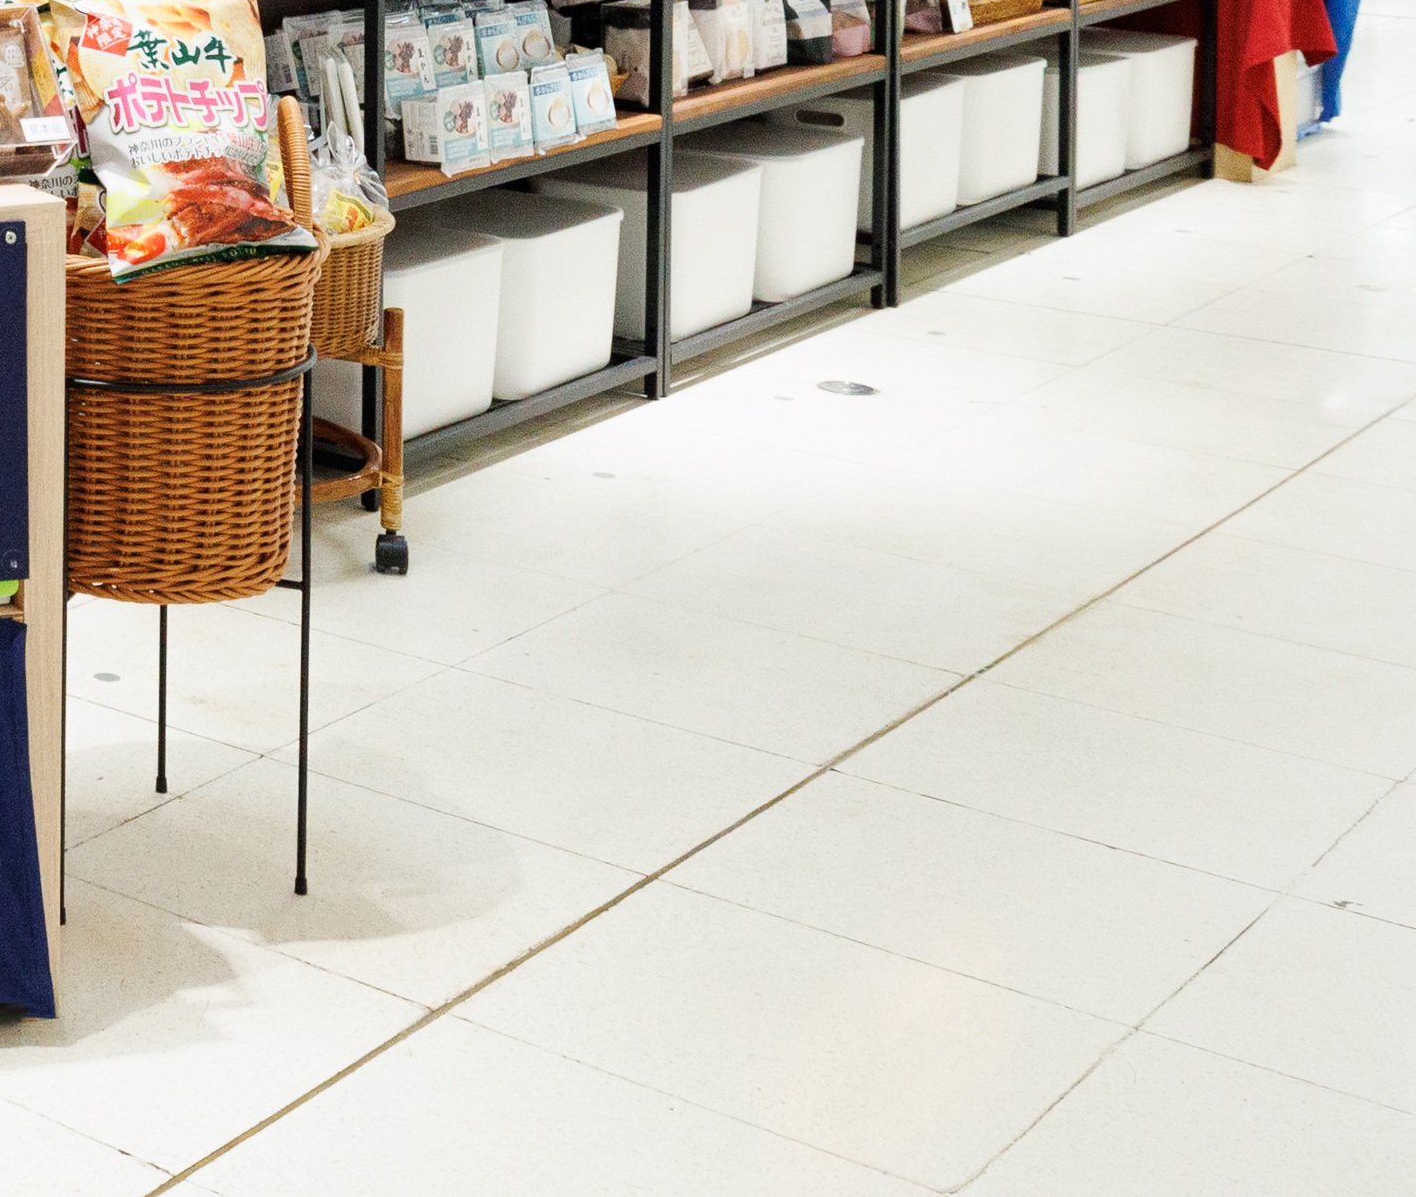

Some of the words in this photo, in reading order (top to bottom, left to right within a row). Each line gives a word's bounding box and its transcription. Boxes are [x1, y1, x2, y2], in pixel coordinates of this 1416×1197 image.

[127, 29, 233, 74] 葉山牛
[108, 74, 267, 133] ポテトチップ
[29, 123, 63, 136] 見本品
